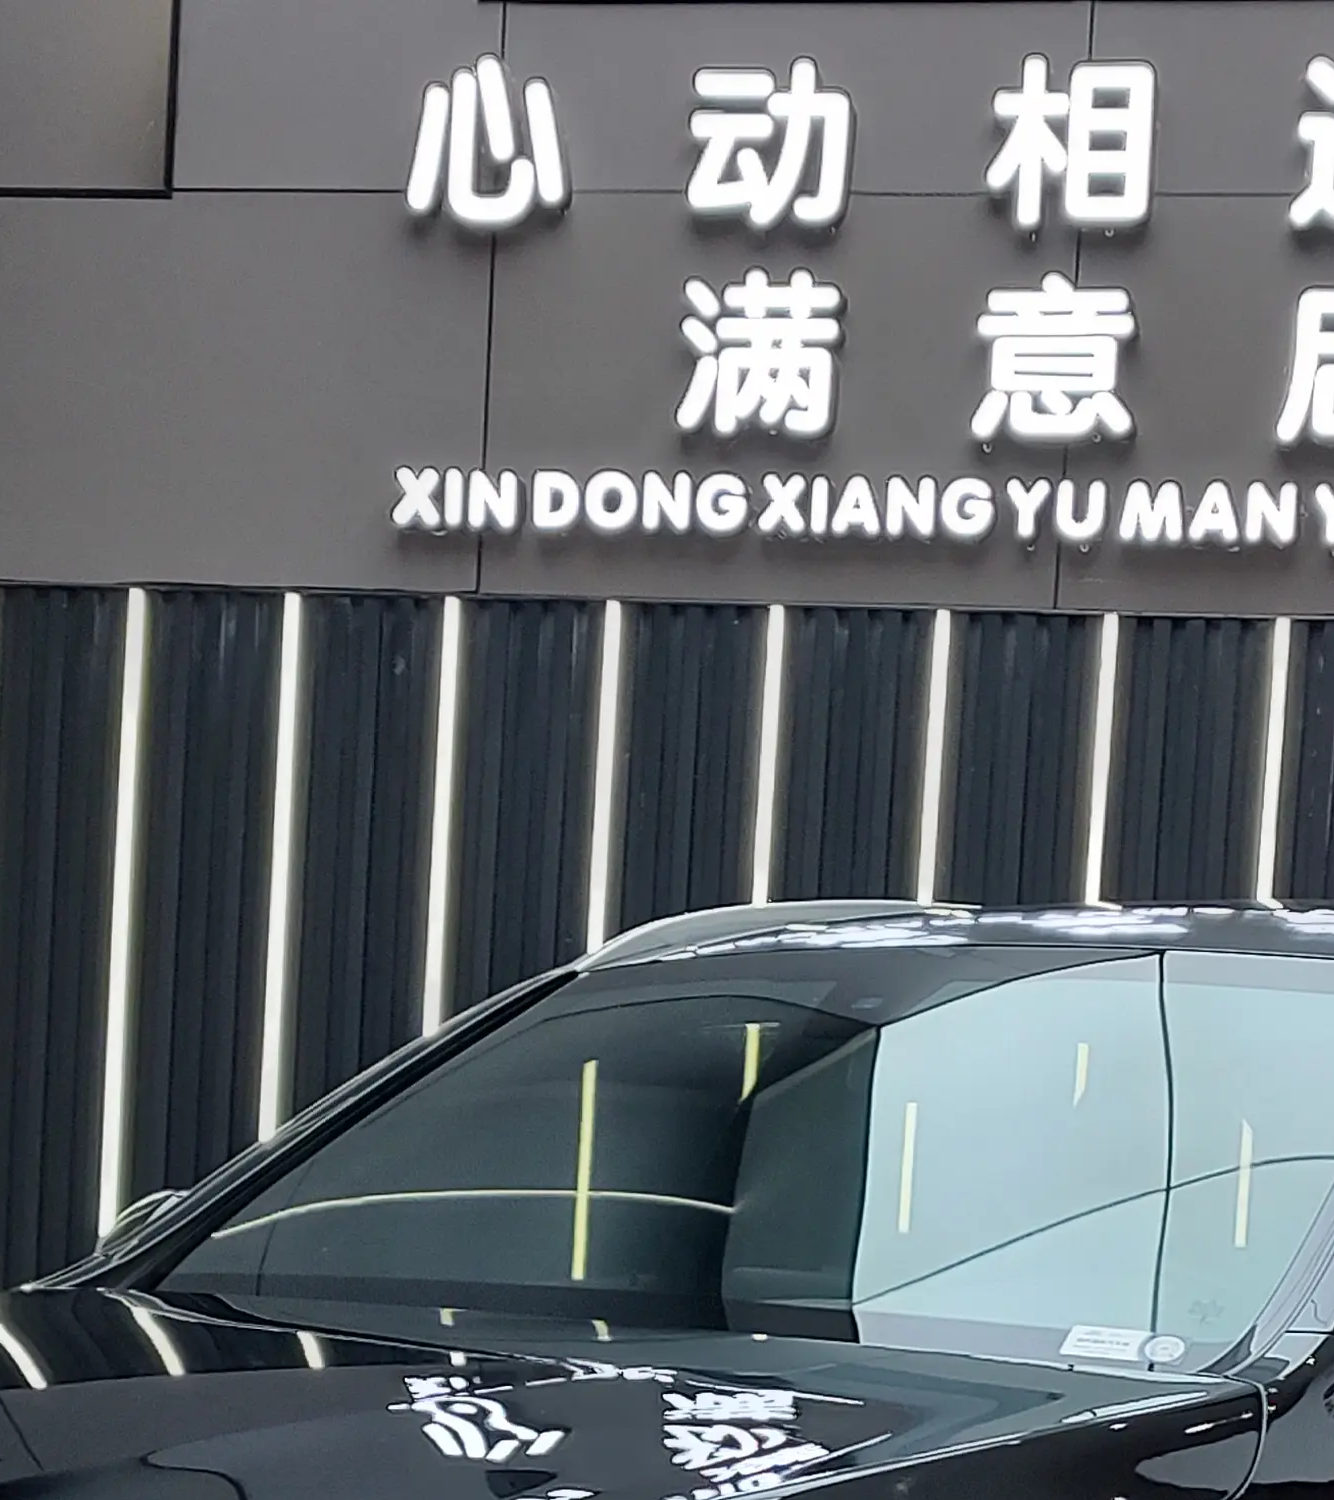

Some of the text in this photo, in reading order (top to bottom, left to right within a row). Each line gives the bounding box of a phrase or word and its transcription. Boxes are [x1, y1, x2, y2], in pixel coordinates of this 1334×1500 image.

[390, 465, 519, 530] XIN
[531, 469, 749, 533] DONG
[756, 472, 995, 537] XIANG
[1005, 477, 1107, 540] YU
[1117, 480, 1299, 543] MAN
